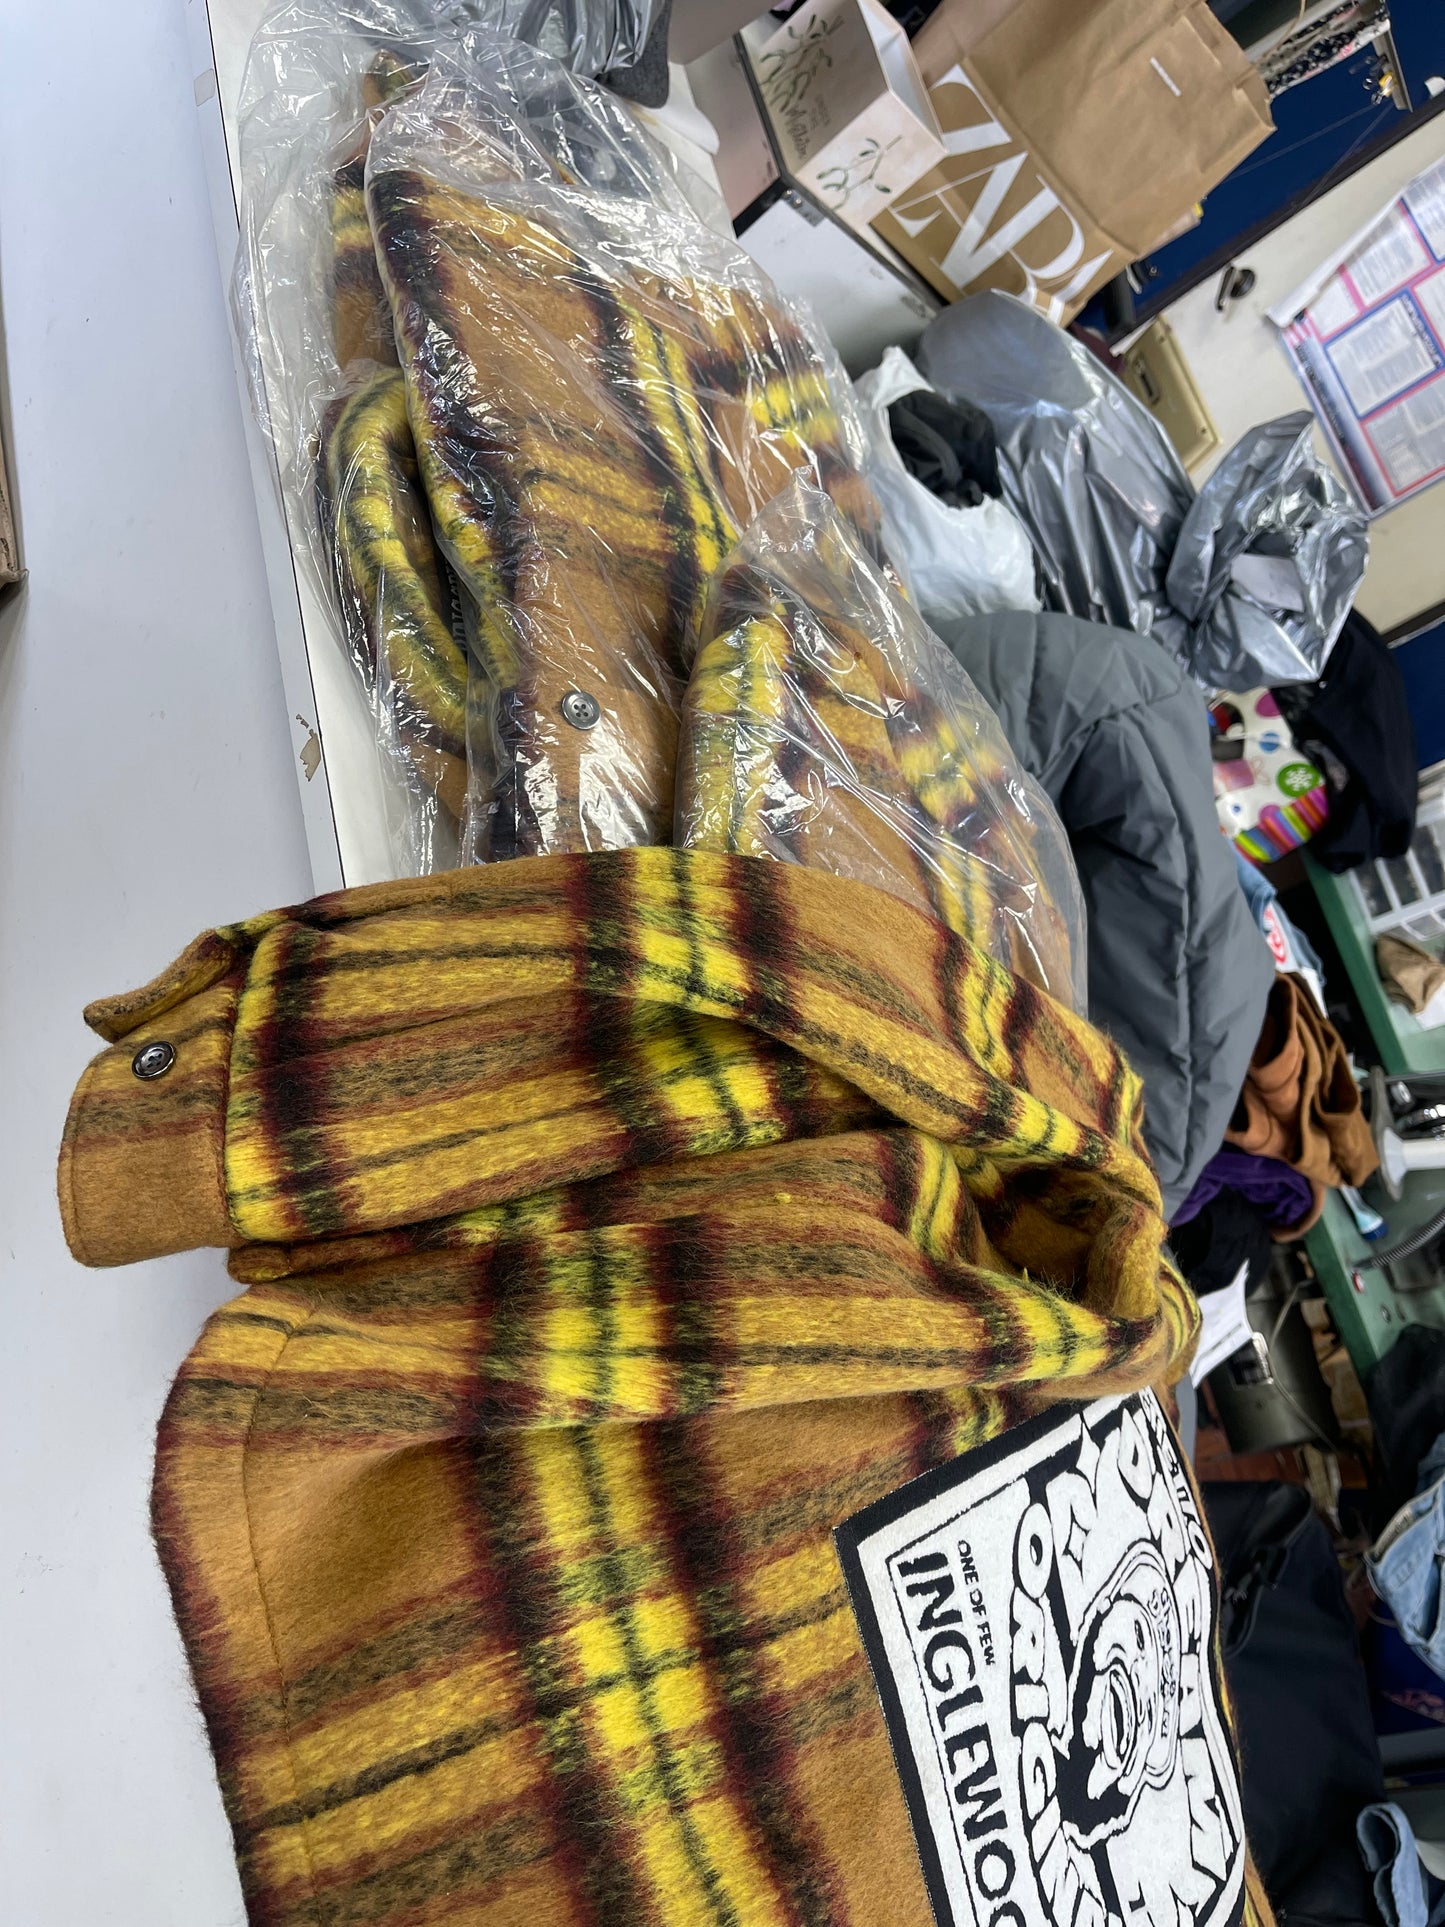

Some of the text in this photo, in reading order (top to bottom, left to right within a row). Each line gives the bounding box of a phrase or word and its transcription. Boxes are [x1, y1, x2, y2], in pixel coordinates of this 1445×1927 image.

[887, 63, 1114, 327] ZARA
[958, 1540, 996, 1666] ONE OF FEW
